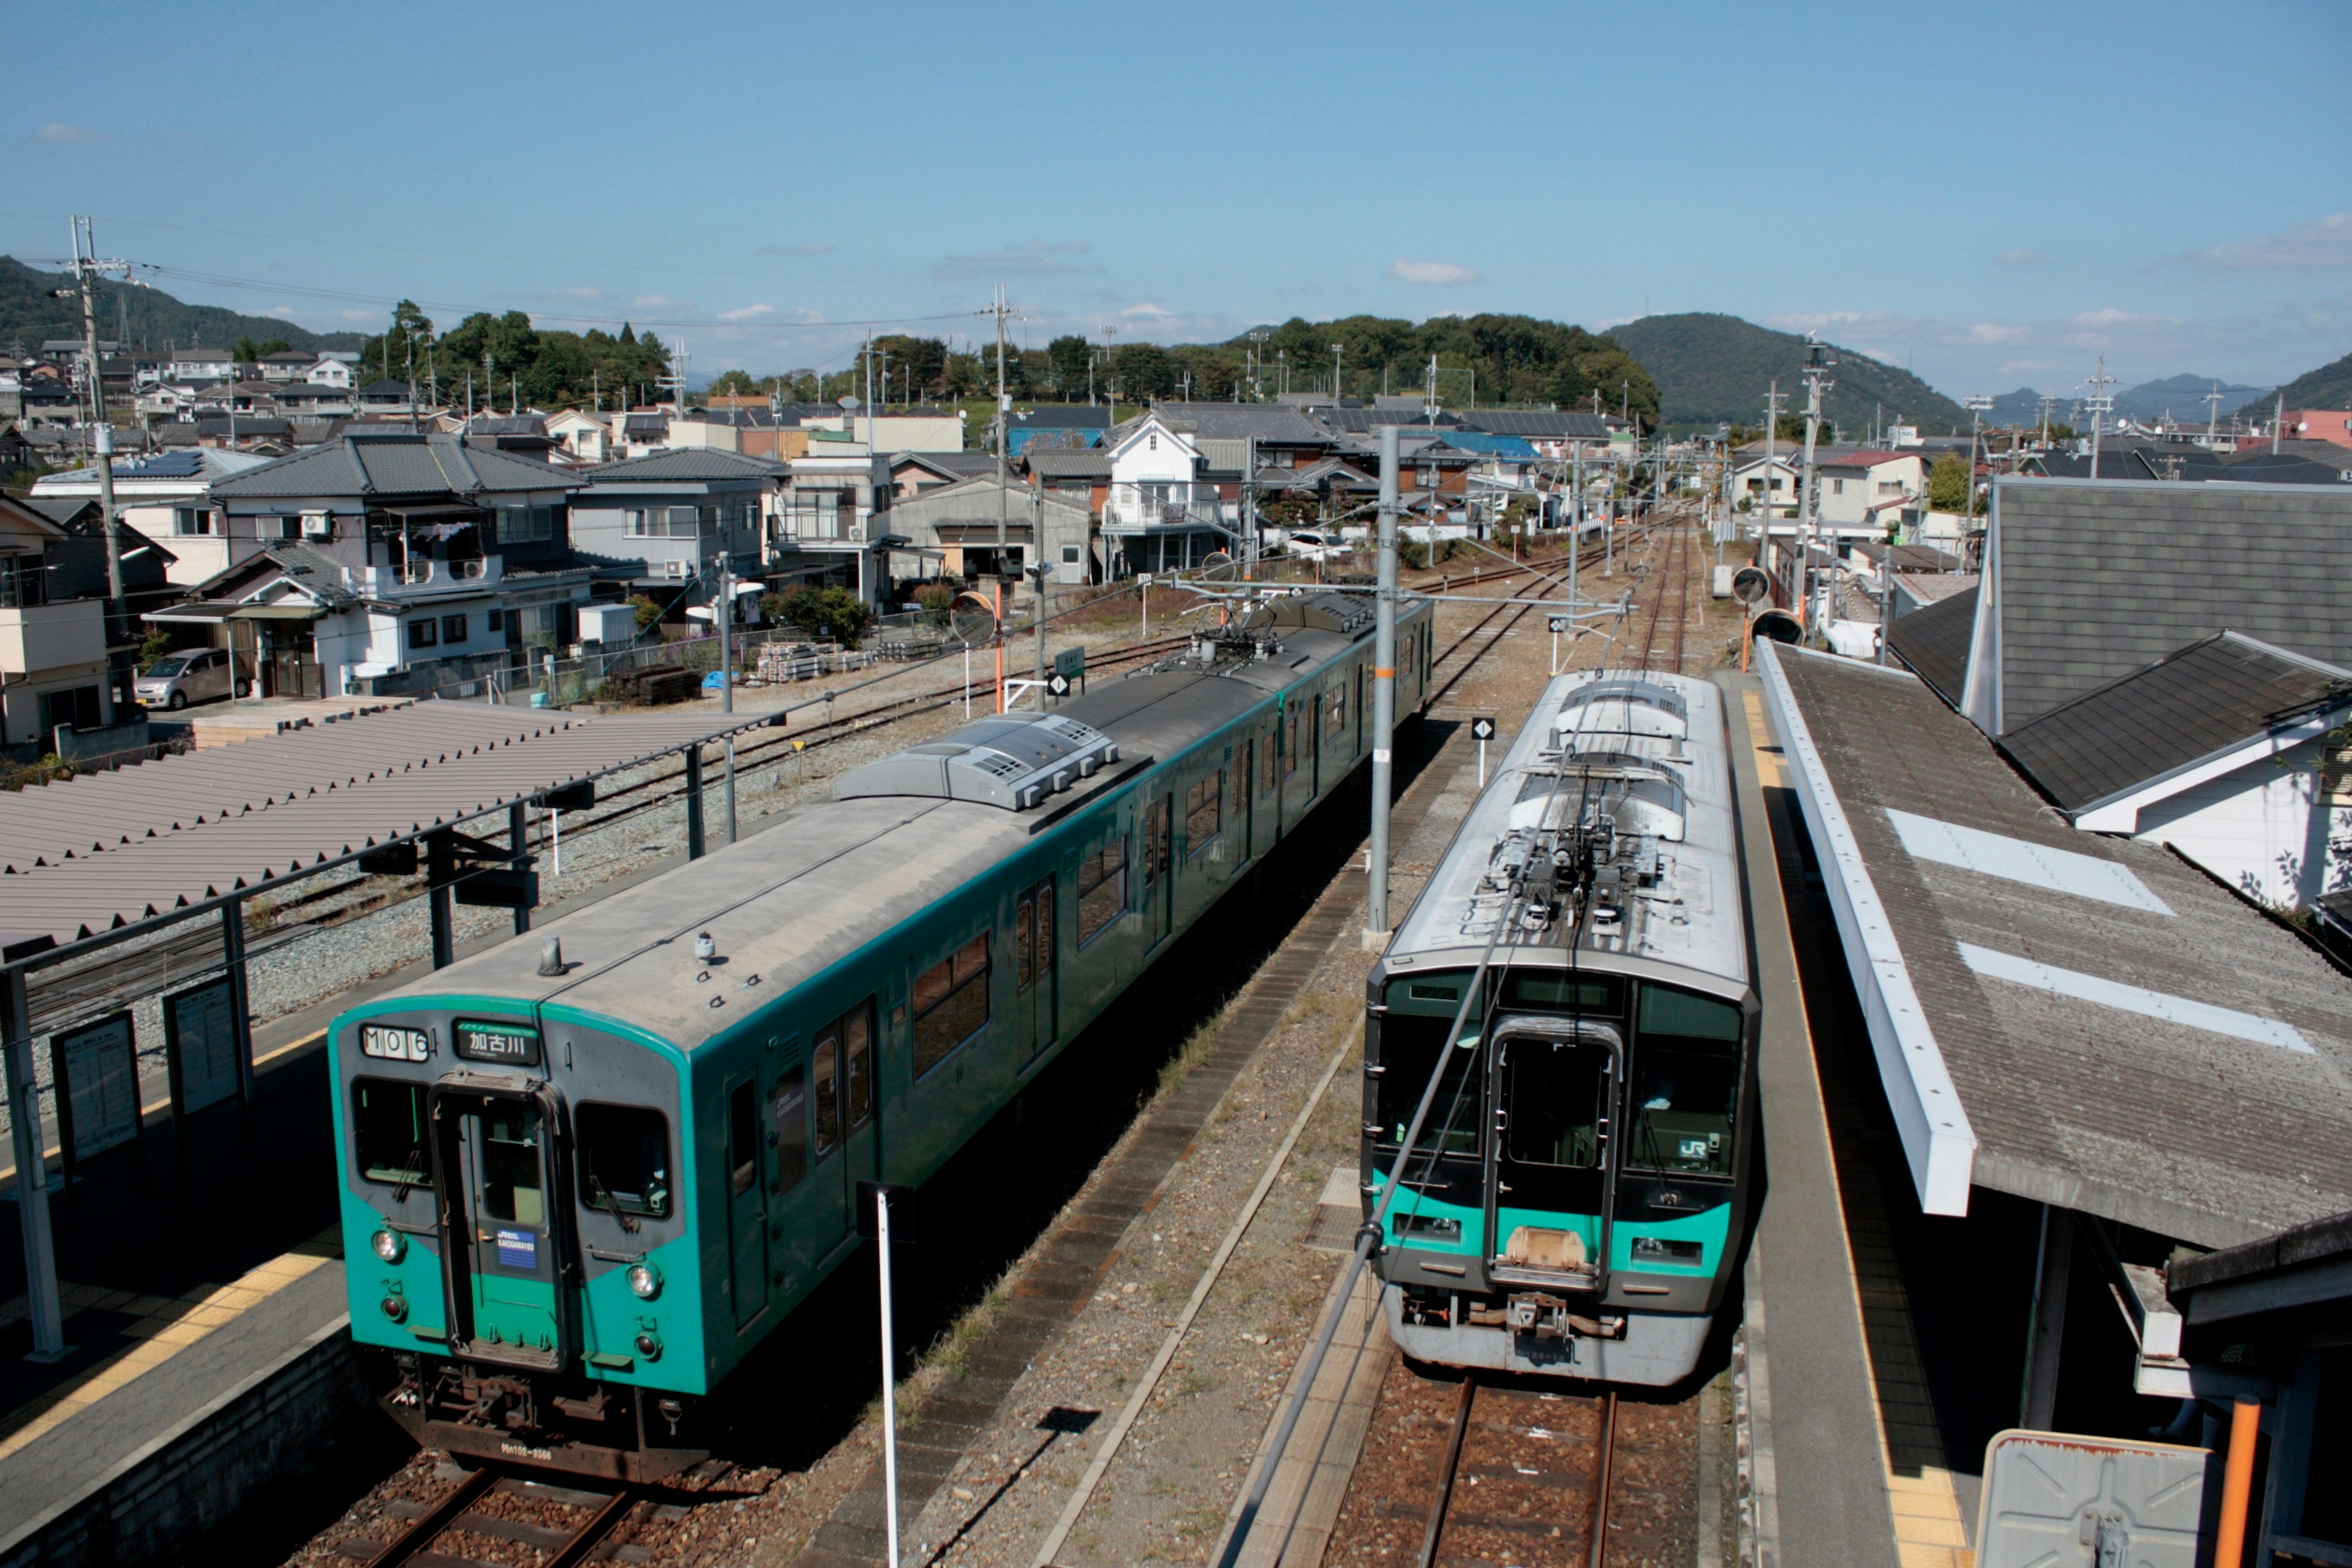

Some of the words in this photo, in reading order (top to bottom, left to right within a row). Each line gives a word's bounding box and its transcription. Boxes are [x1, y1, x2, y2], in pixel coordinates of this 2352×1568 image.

[470, 1032, 525, 1055] 加古川
[1681, 1140, 1706, 1156] JR
